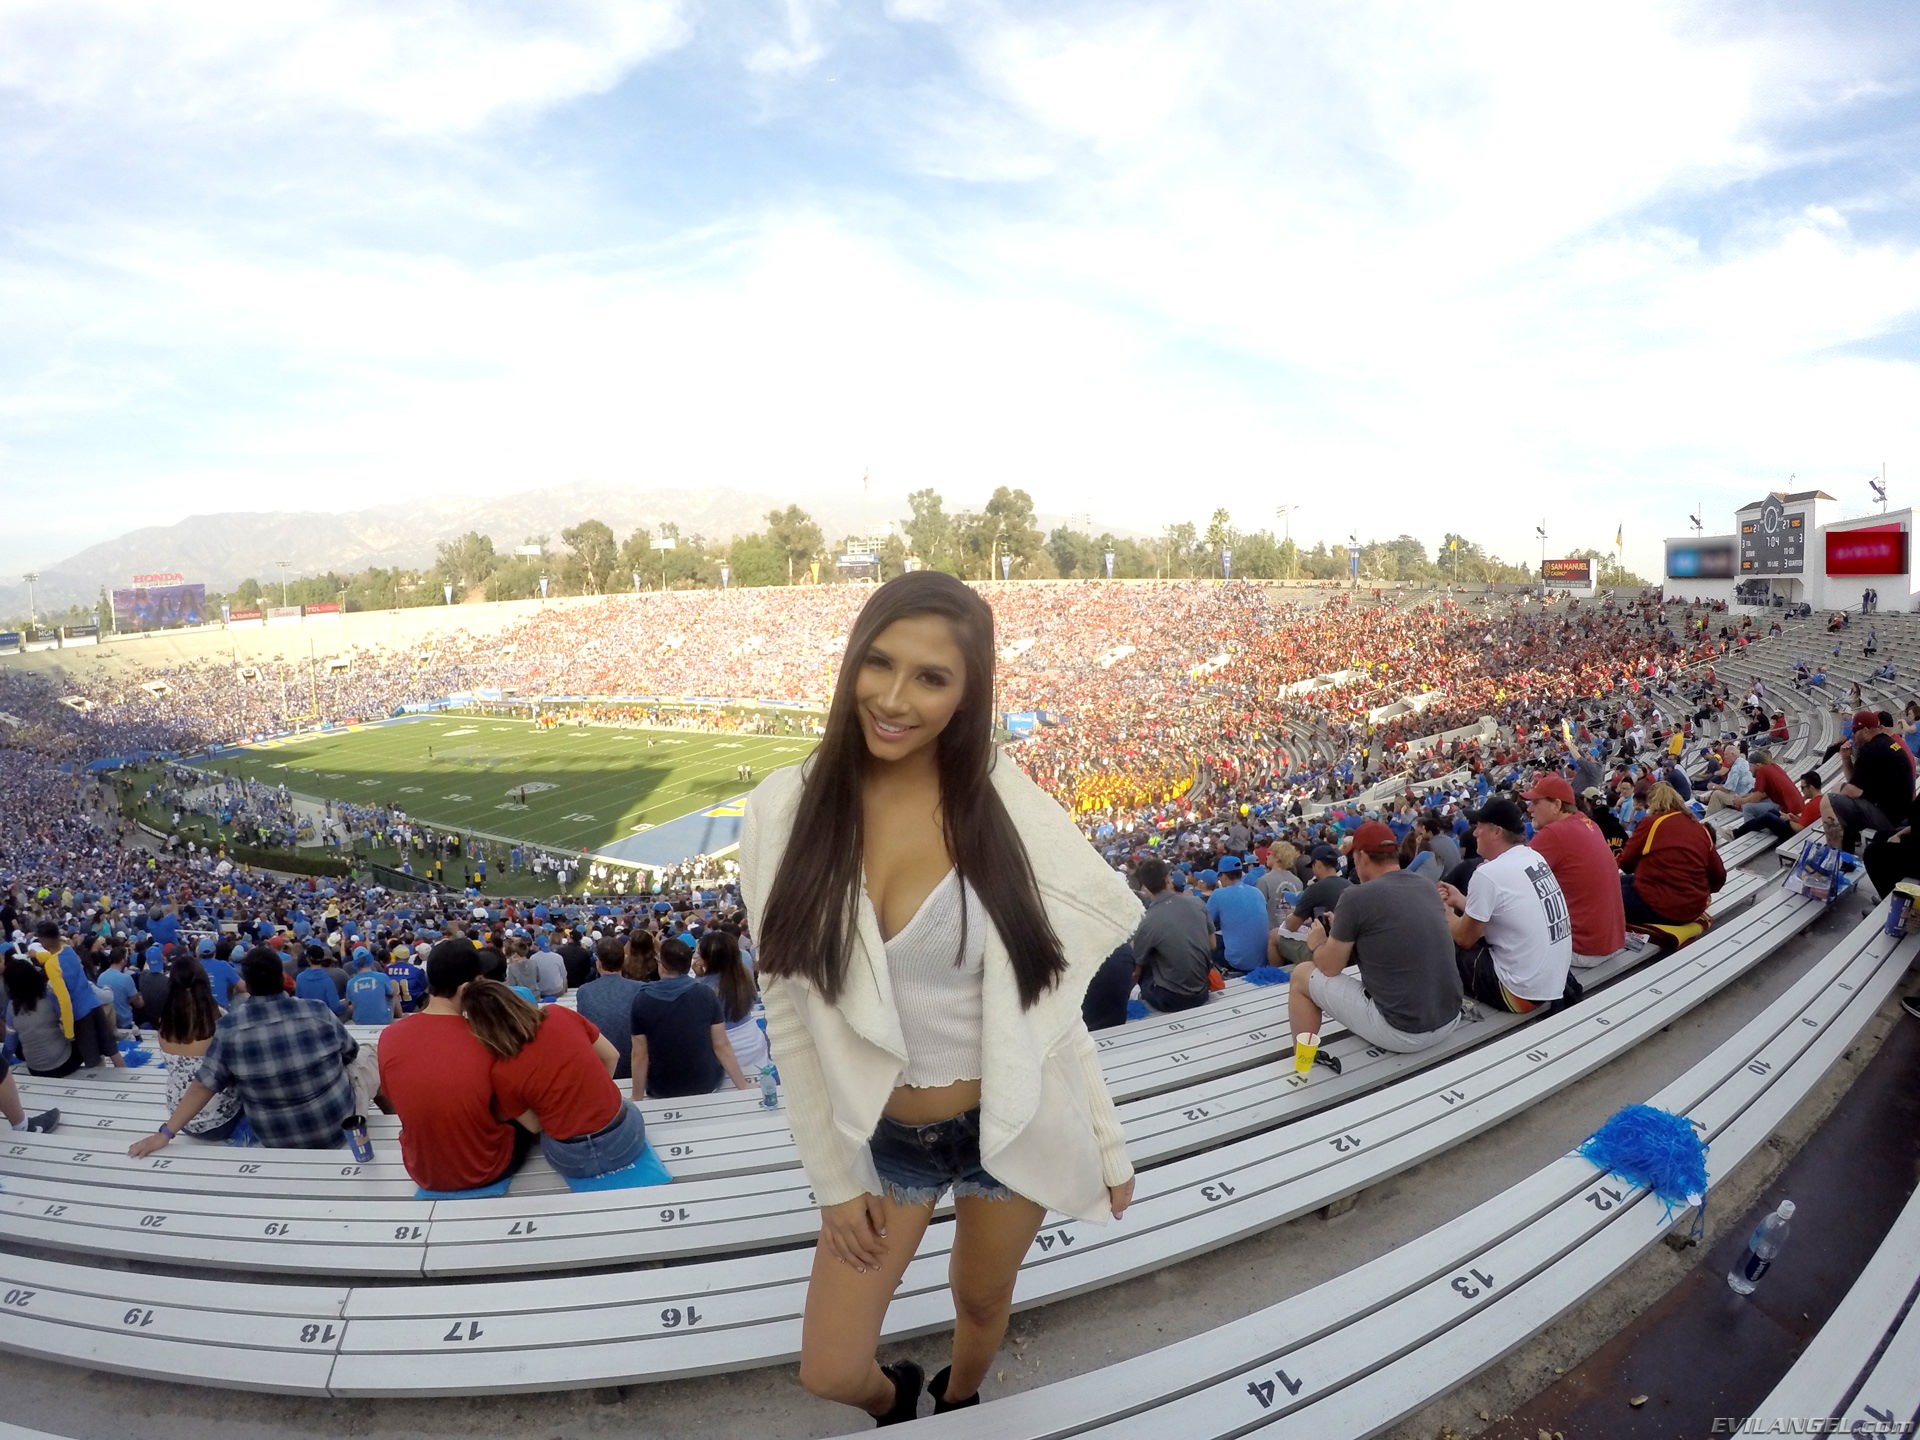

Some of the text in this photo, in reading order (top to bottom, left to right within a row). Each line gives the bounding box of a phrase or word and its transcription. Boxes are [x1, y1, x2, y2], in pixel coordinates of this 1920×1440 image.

[1551, 562, 1588, 570] SAN MANUEL
[132, 573, 184, 583] HONDA
[388, 967, 410, 976] UCLA
[1167, 1022, 1186, 1033] 10
[1246, 1030, 1268, 1042] 10
[1098, 1039, 1115, 1049] 11
[1169, 1052, 1191, 1064] 11
[1525, 1048, 1550, 1063] 10
[1746, 1058, 1773, 1077] 10
[1438, 1089, 1466, 1105] 11
[662, 1111, 684, 1121] 16
[1181, 1106, 1210, 1122] 12
[96, 1119, 116, 1128] 23
[1328, 1133, 1363, 1152] 12
[8, 1146, 29, 1155] 23
[71, 1152, 94, 1162] 22
[669, 1145, 694, 1157] 16
[151, 1159, 174, 1169] 21
[237, 1163, 262, 1174] 20
[340, 1166, 363, 1176] 19
[1199, 1181, 1236, 1202] 13
[1584, 1186, 1623, 1211] 12
[43, 1204, 69, 1217] 21
[659, 1208, 692, 1223] 16
[139, 1214, 168, 1228] 20
[506, 1220, 538, 1236] 17
[263, 1222, 291, 1236] 19
[393, 1226, 423, 1241] 18
[1034, 1229, 1076, 1252] 14
[1450, 1268, 1495, 1300] 13
[3, 1288, 37, 1308] 20
[122, 1307, 155, 1327] 19
[660, 1305, 703, 1329] 16
[299, 1323, 337, 1343] 18
[442, 1320, 485, 1343] 17
[1246, 1368, 1304, 1409] 14
